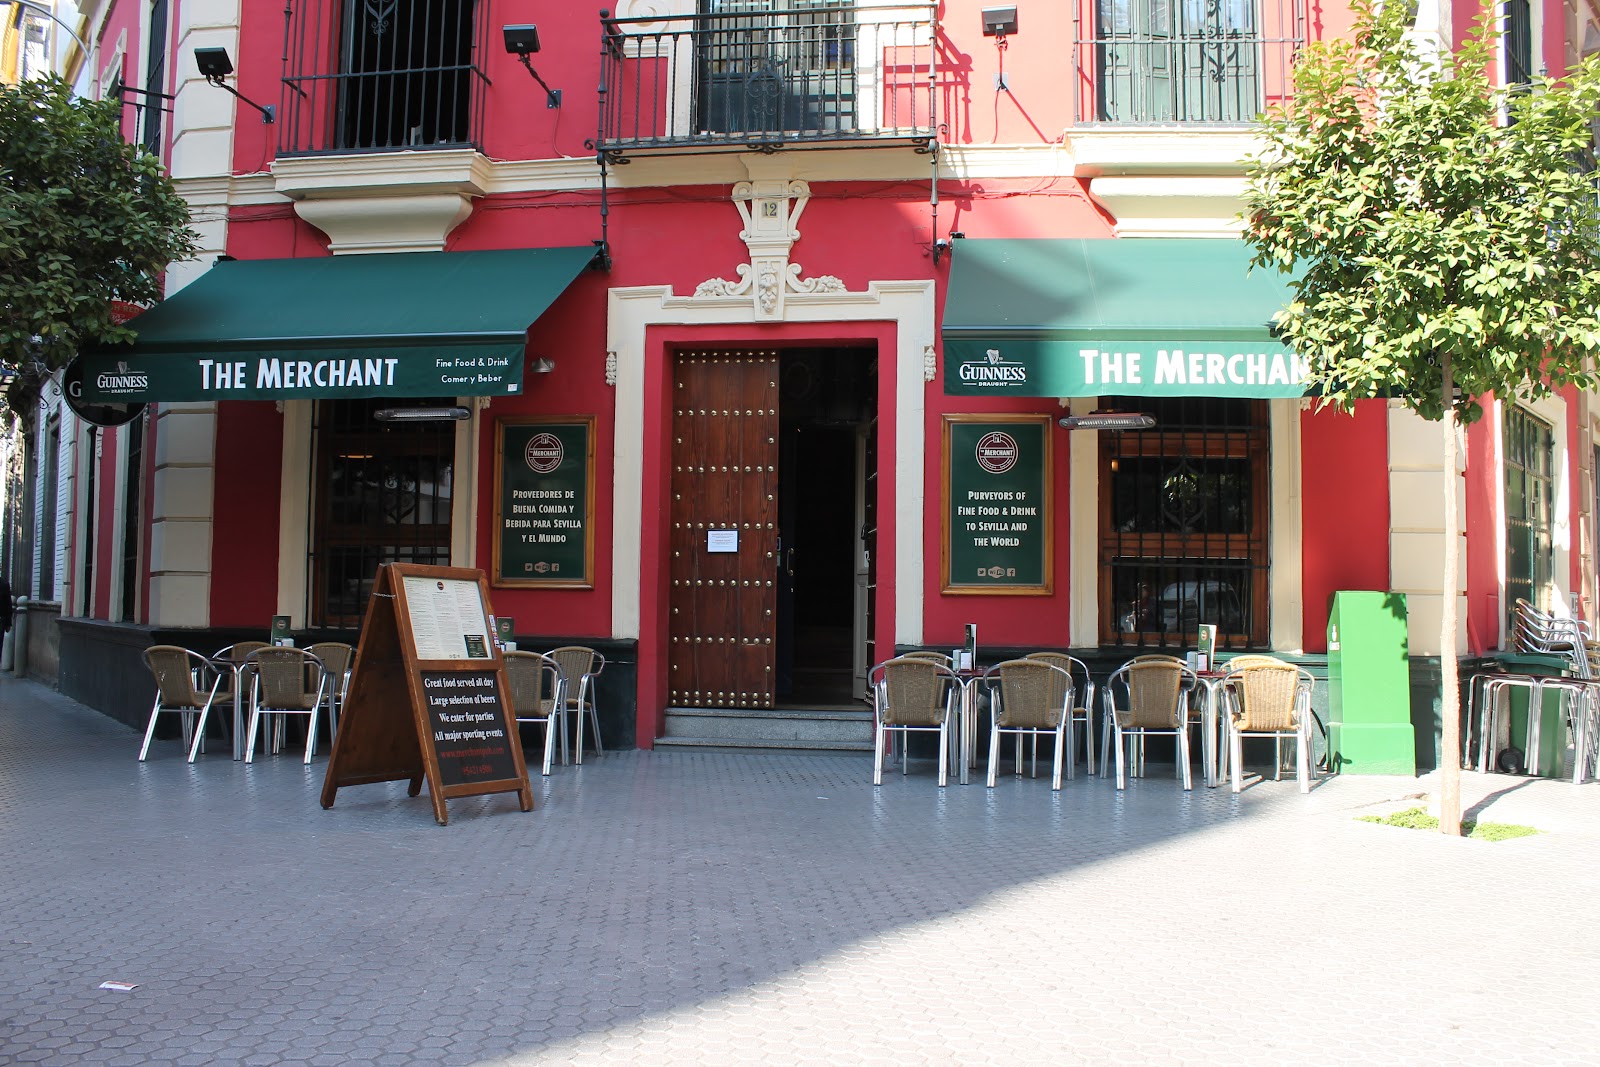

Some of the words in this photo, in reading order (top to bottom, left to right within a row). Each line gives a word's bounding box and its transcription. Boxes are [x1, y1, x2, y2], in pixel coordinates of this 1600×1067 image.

[764, 202, 777, 217] 12
[436, 359, 452, 368] Fine
[455, 358, 476, 367] Food
[478, 358, 485, 367] &
[487, 357, 509, 367] Drink
[1080, 349, 1141, 384] THE
[1154, 349, 1327, 386] MERCHAN
[199, 359, 247, 389] THE
[256, 358, 398, 389] MERCHANT
[959, 363, 1027, 382] GUINNESS
[97, 374, 148, 389] GUINNESS
[441, 374, 468, 383] Comer
[470, 376, 476, 385] y
[478, 374, 502, 383] Beber
[513, 489, 562, 499] PROVEEDORES
[564, 490, 575, 499] DE
[968, 490, 1014, 501] PURVEYORS
[1016, 491, 1026, 501] OF
[512, 504, 537, 514] BUENA
[538, 504, 568, 514] COMIDA
[568, 505, 575, 514] Y
[957, 506, 976, 516] FINE
[978, 506, 1000, 516] FOOD
[1002, 507, 1009, 516] &
[1010, 506, 1037, 516] DRINK
[505, 519, 531, 528] BEBIDA
[533, 519, 552, 528] PARA
[553, 519, 582, 528] SEVILLA
[965, 522, 977, 531] TO
[978, 521, 1009, 531] SEVILLA
[1010, 522, 1028, 531] AND
[521, 534, 527, 543] Y
[528, 534, 537, 543] EL
[538, 534, 567, 543] MUNDO
[973, 537, 989, 547] THE
[990, 536, 1020, 547] WORLD
[424, 678, 442, 688] Great
[442, 677, 456, 688] food
[456, 678, 475, 688] served
[475, 678, 483, 687] all
[483, 678, 494, 688] day
[429, 695, 449, 707] Large
[448, 695, 473, 705] selection
[473, 694, 480, 704] of
[480, 694, 496, 704] beers
[439, 712, 450, 722] We
[450, 714, 465, 722] cater
[465, 711, 474, 722] for
[474, 712, 495, 723] parties
[434, 731, 444, 741] All
[444, 730, 462, 742] major
[462, 729, 486, 741] sporting
[486, 728, 503, 738] events
